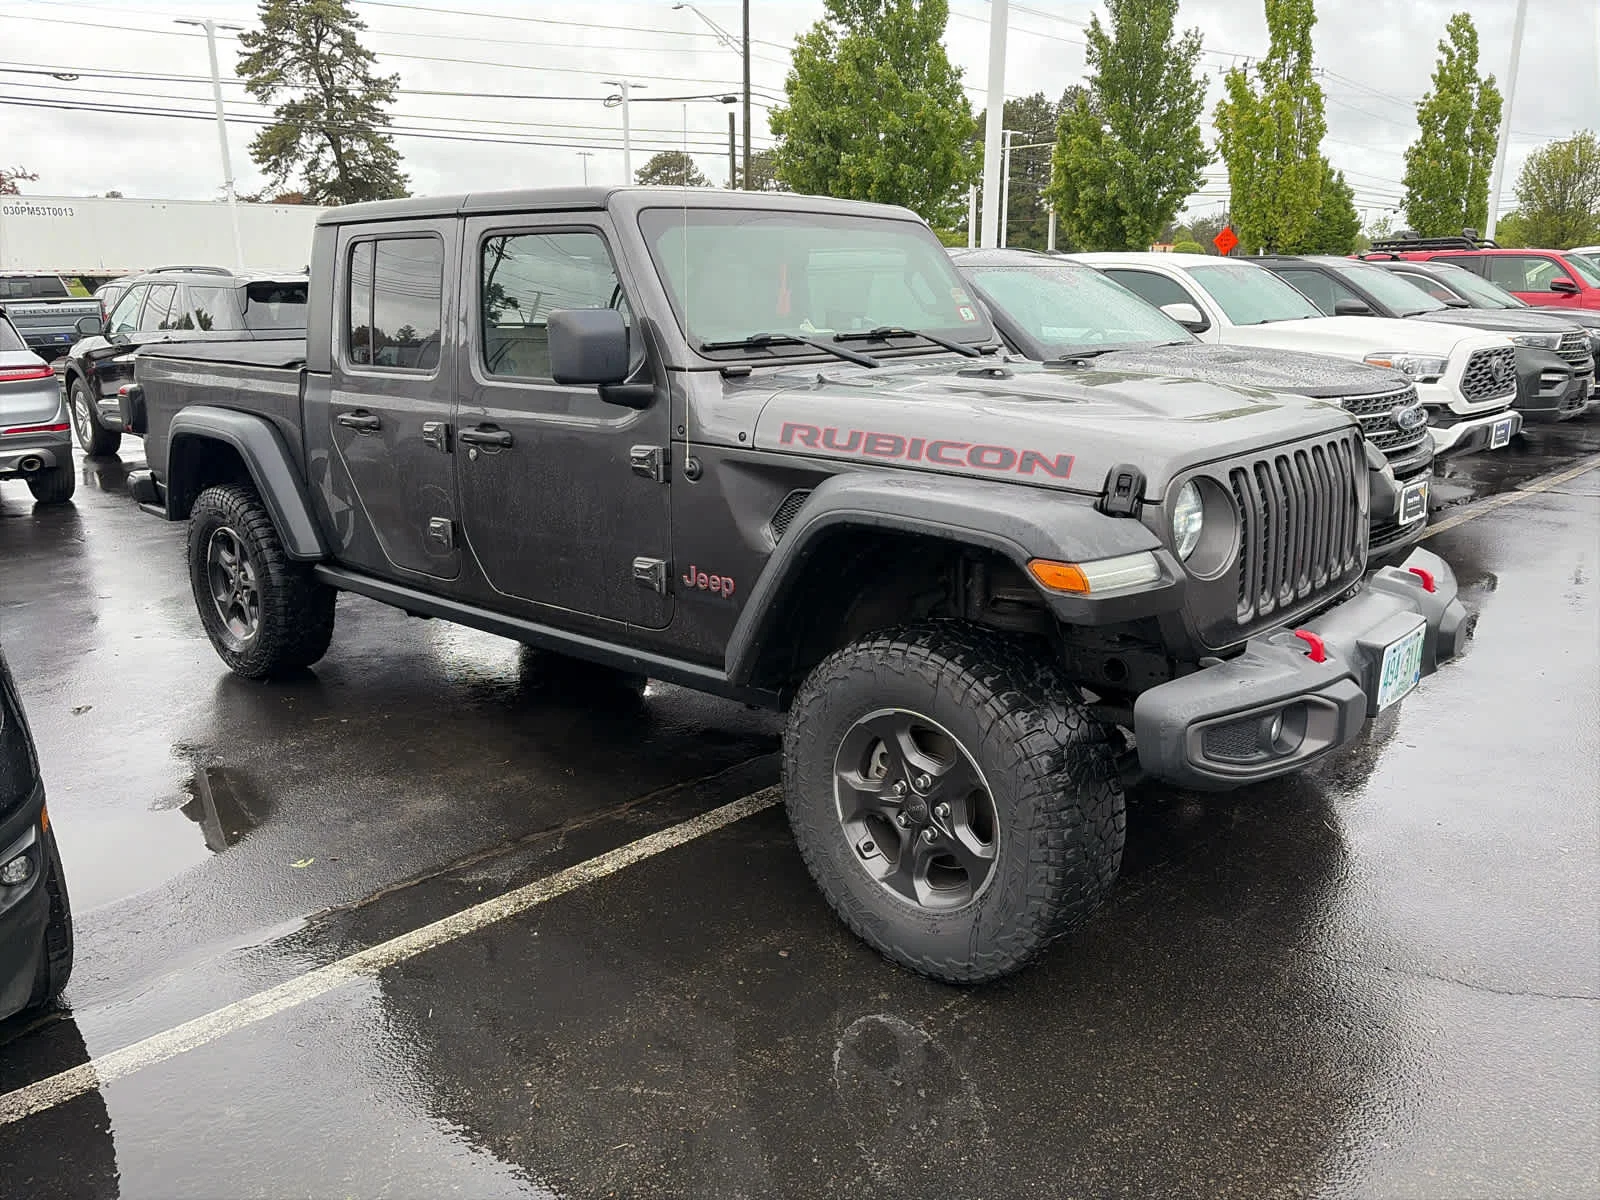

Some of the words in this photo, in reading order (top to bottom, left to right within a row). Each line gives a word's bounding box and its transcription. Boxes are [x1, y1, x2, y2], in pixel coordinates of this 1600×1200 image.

[3, 205, 74, 217] 030PM53T0013
[12, 307, 97, 315] CHEVROLET
[779, 422, 1076, 479] RUBICON
[682, 564, 736, 599] Jeep
